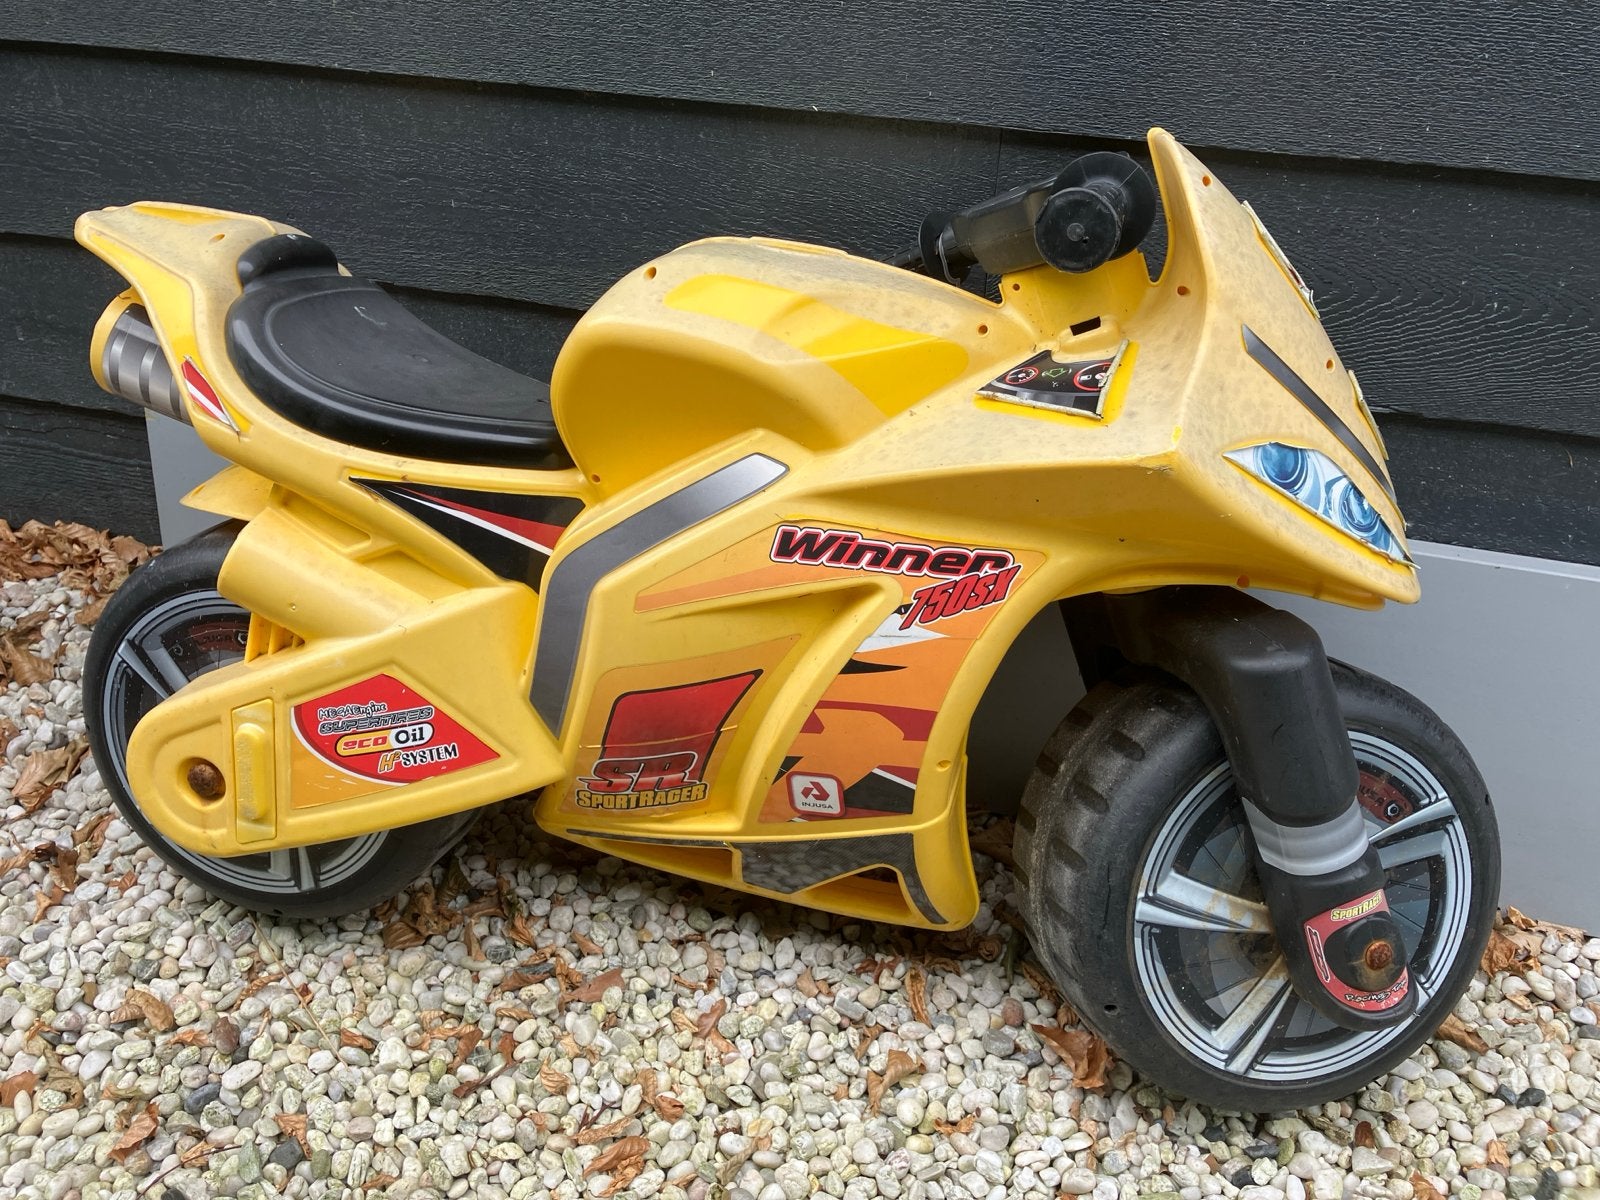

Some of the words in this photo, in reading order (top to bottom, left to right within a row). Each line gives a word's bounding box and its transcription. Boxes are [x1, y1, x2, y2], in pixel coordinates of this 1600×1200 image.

[770, 525, 1015, 578] Winner
[318, 706, 434, 735] SUPERTIRES
[343, 736, 388, 750] eco
[394, 727, 425, 744] Oil
[576, 751, 699, 793] SR
